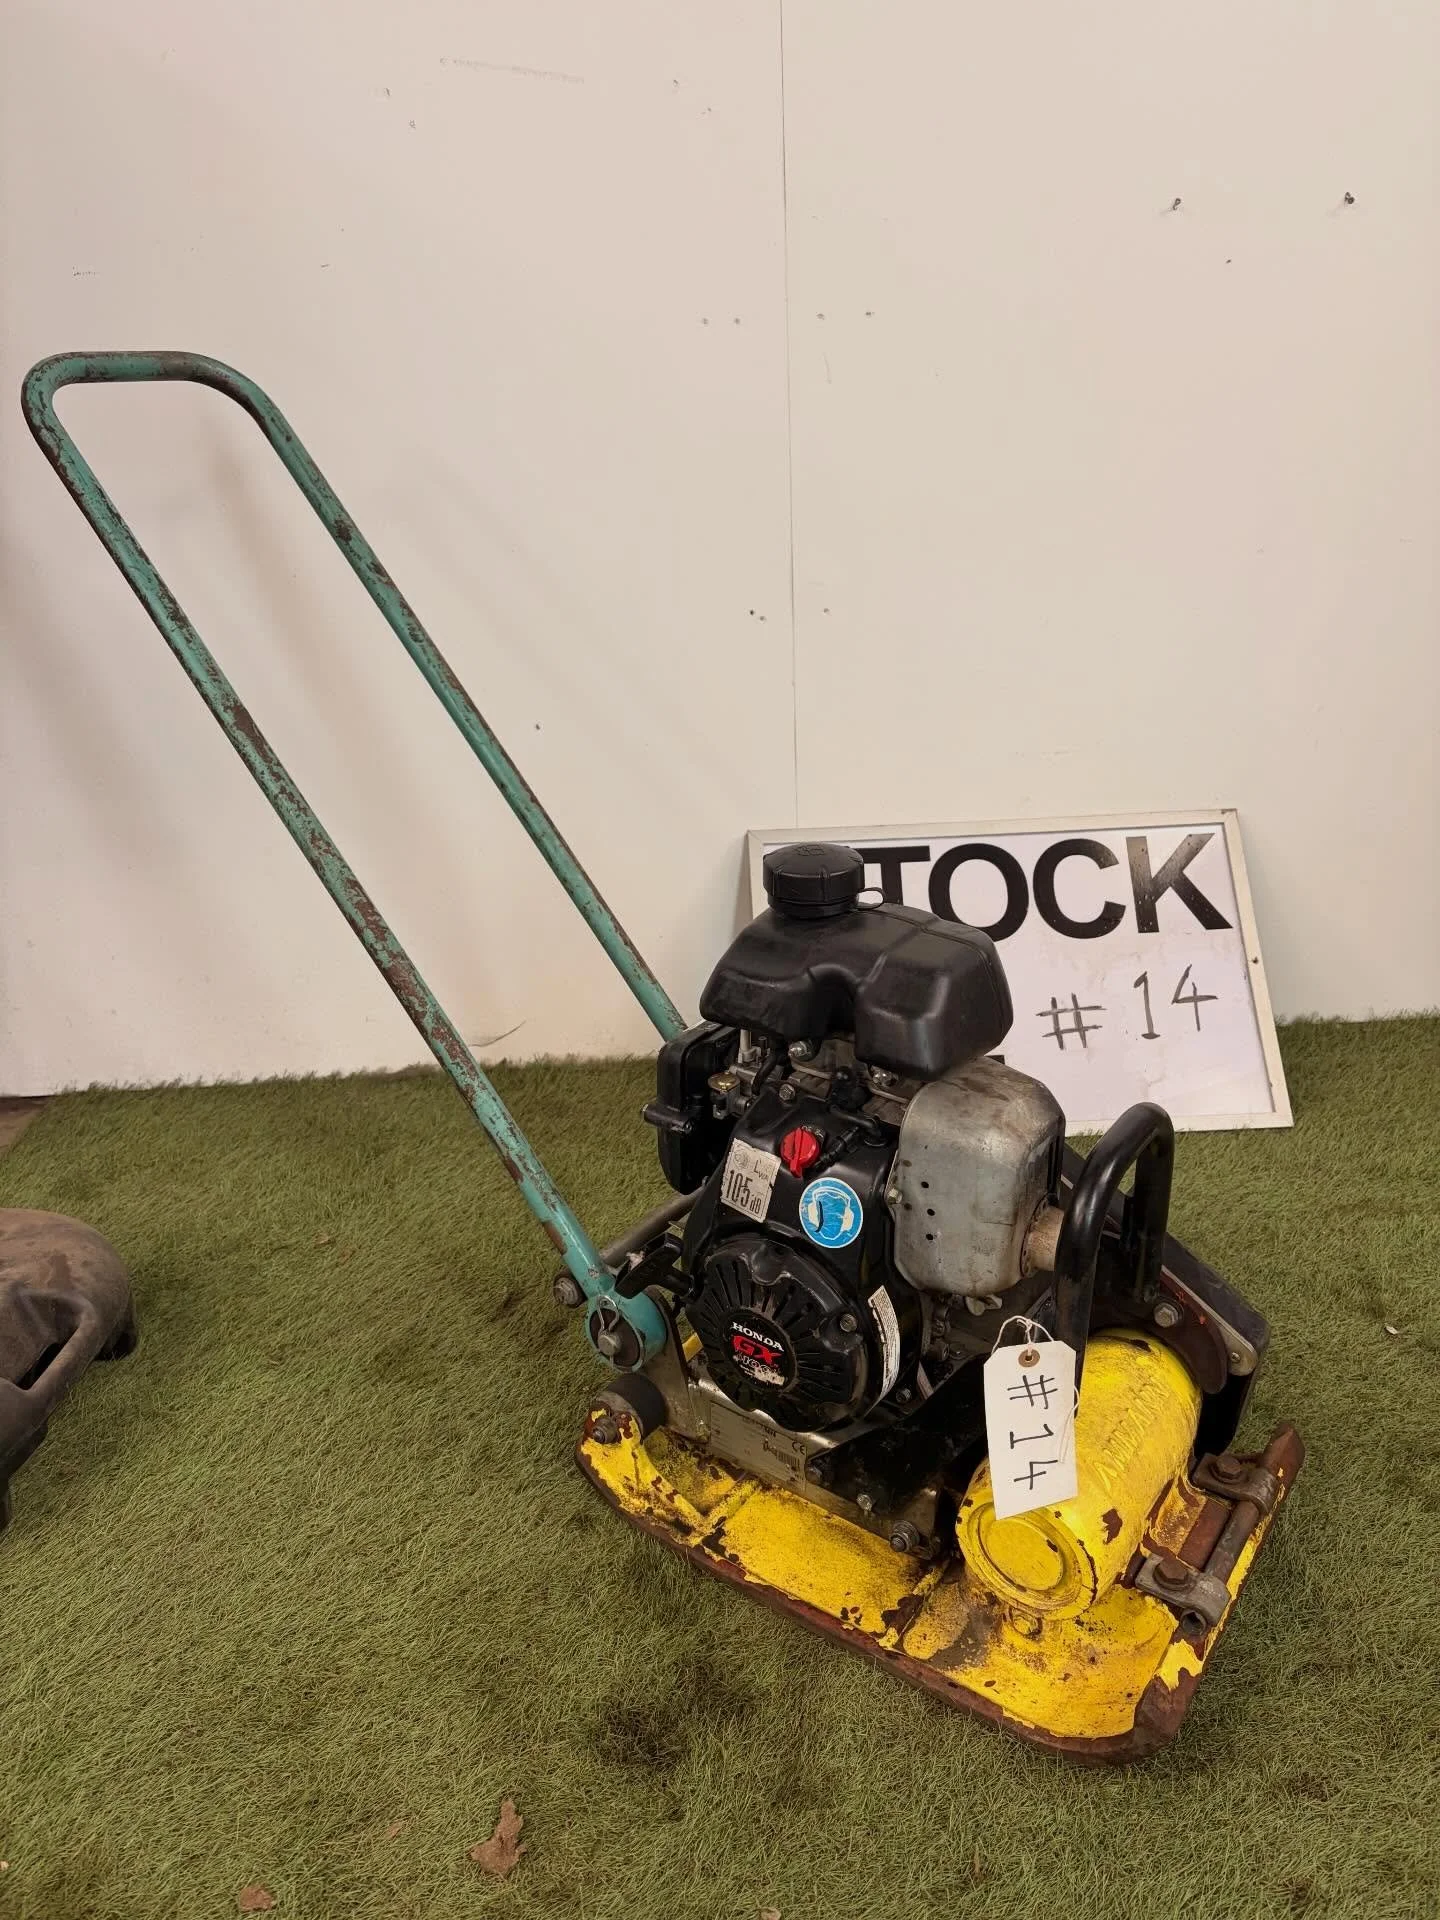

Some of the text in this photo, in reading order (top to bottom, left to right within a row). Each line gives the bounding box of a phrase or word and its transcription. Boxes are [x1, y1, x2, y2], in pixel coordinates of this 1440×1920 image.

[848, 832, 1233, 943] TOCK
[726, 1169, 753, 1208] 105
[730, 1321, 785, 1352] HONDA
[733, 1335, 783, 1366] GX
